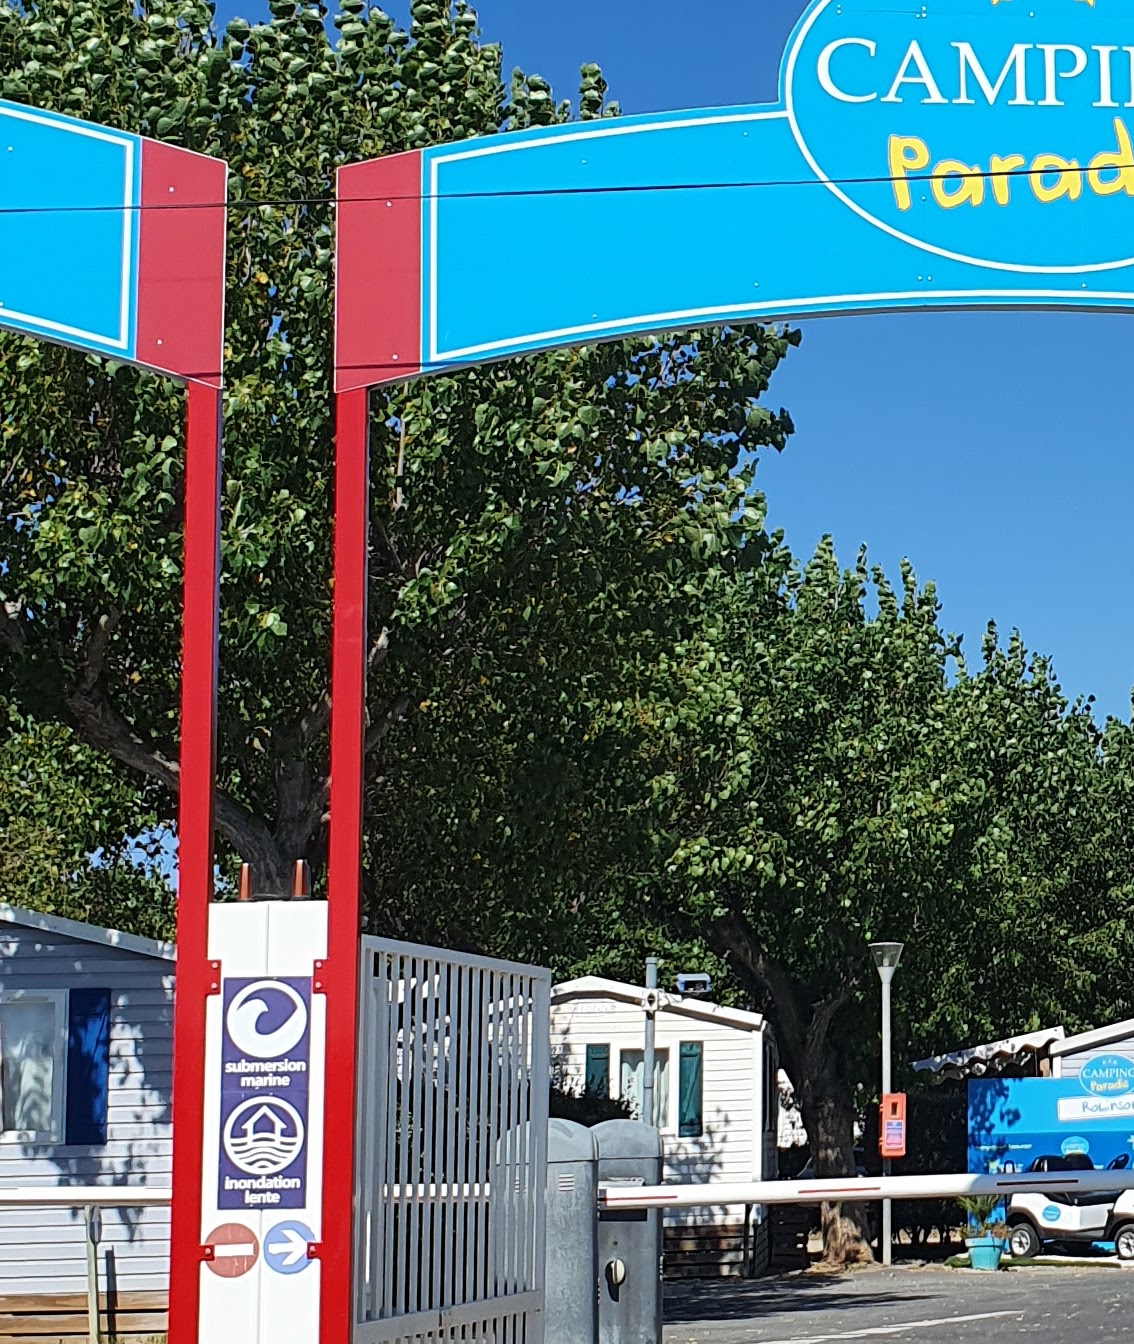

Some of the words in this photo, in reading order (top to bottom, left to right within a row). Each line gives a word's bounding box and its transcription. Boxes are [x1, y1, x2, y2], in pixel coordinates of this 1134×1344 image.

[225, 1058, 307, 1073] submersion
[240, 1073, 291, 1087] marine
[224, 1174, 301, 1190] inondation
[244, 1189, 281, 1204] lente
